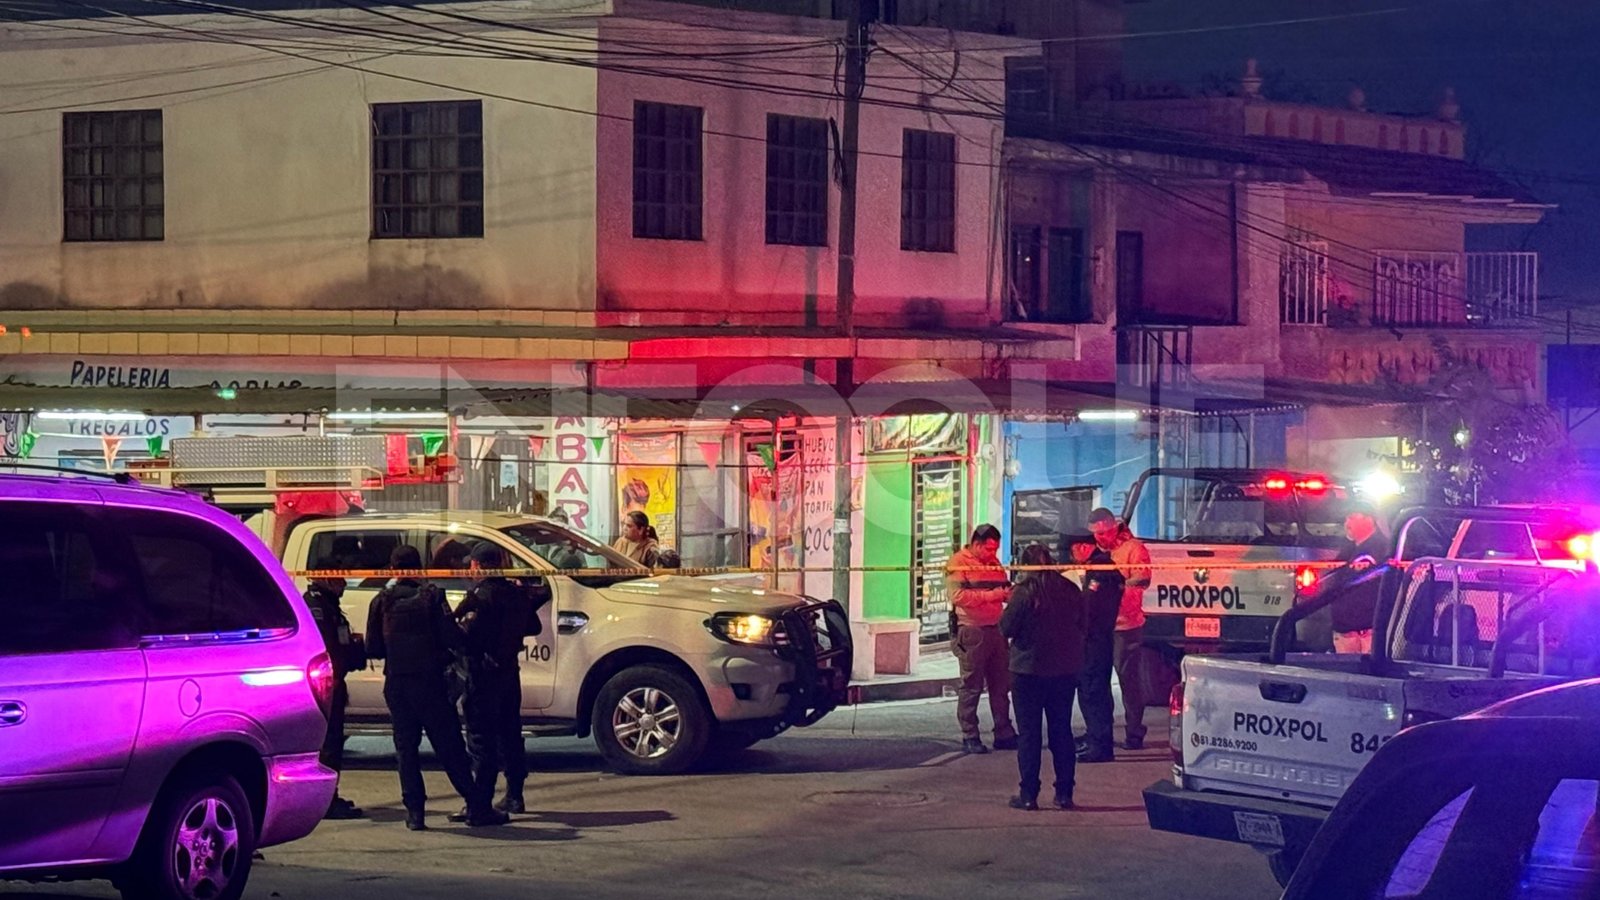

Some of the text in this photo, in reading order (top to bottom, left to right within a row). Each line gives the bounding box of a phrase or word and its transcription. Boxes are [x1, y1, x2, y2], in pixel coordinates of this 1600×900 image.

[70, 360, 170, 388] PAPELERIA
[804, 437, 834, 453] HUEVO
[804, 480, 824, 497] PAN
[1157, 584, 1246, 610] PROXPOL
[524, 644, 551, 662] 140
[1233, 711, 1329, 743] PROXPOL
